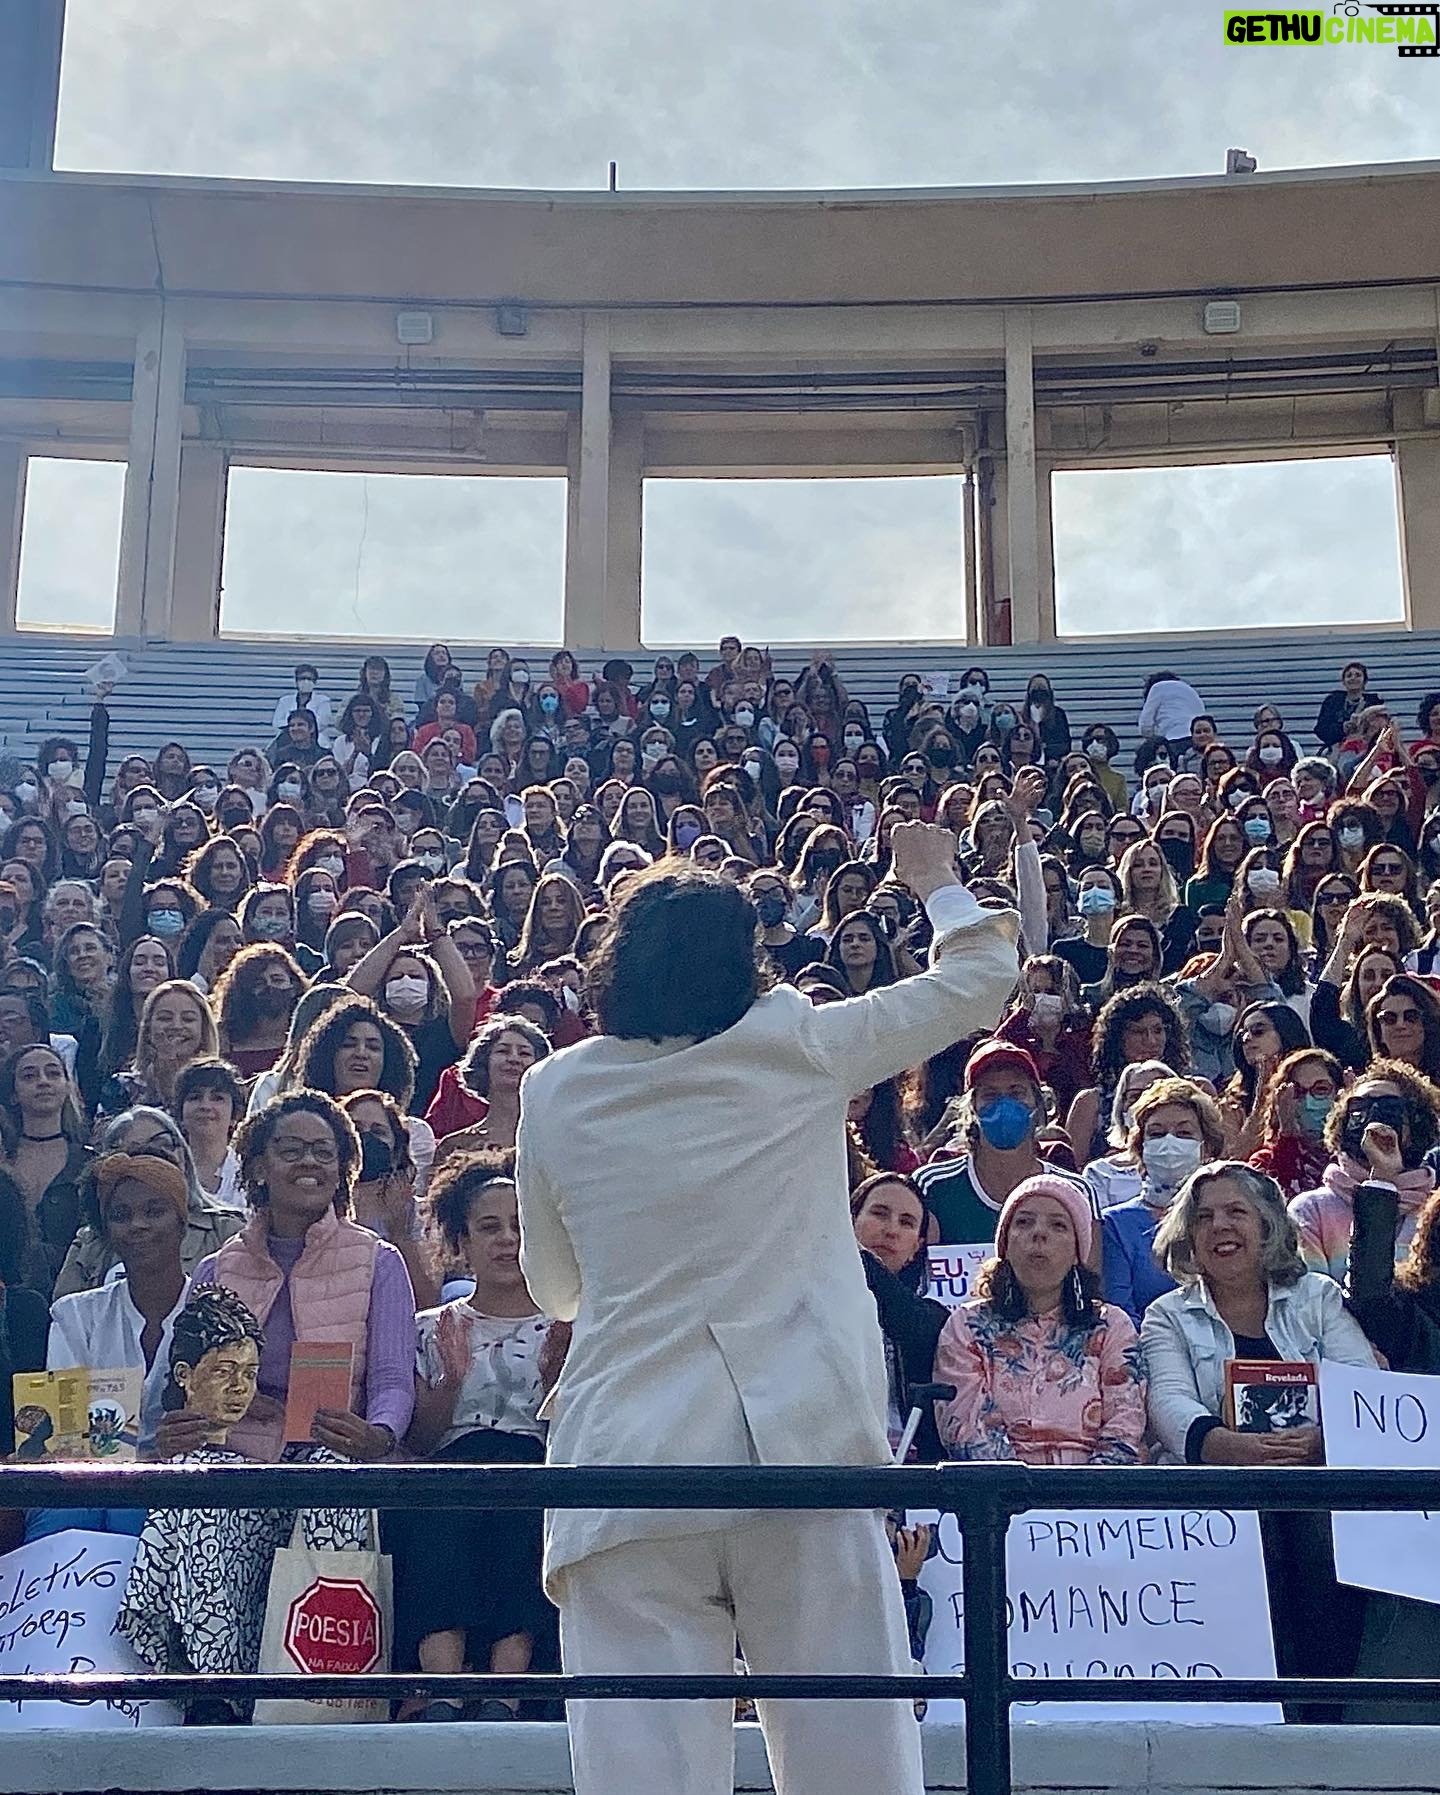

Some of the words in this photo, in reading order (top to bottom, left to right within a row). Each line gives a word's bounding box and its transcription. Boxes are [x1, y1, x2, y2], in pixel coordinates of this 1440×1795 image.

[1265, 1373, 1308, 1382] Revelada
[1353, 1390, 1428, 1443] NO
[1021, 1509, 1236, 1559] PRIMEIRO
[295, 1612, 375, 1646] POESIA
